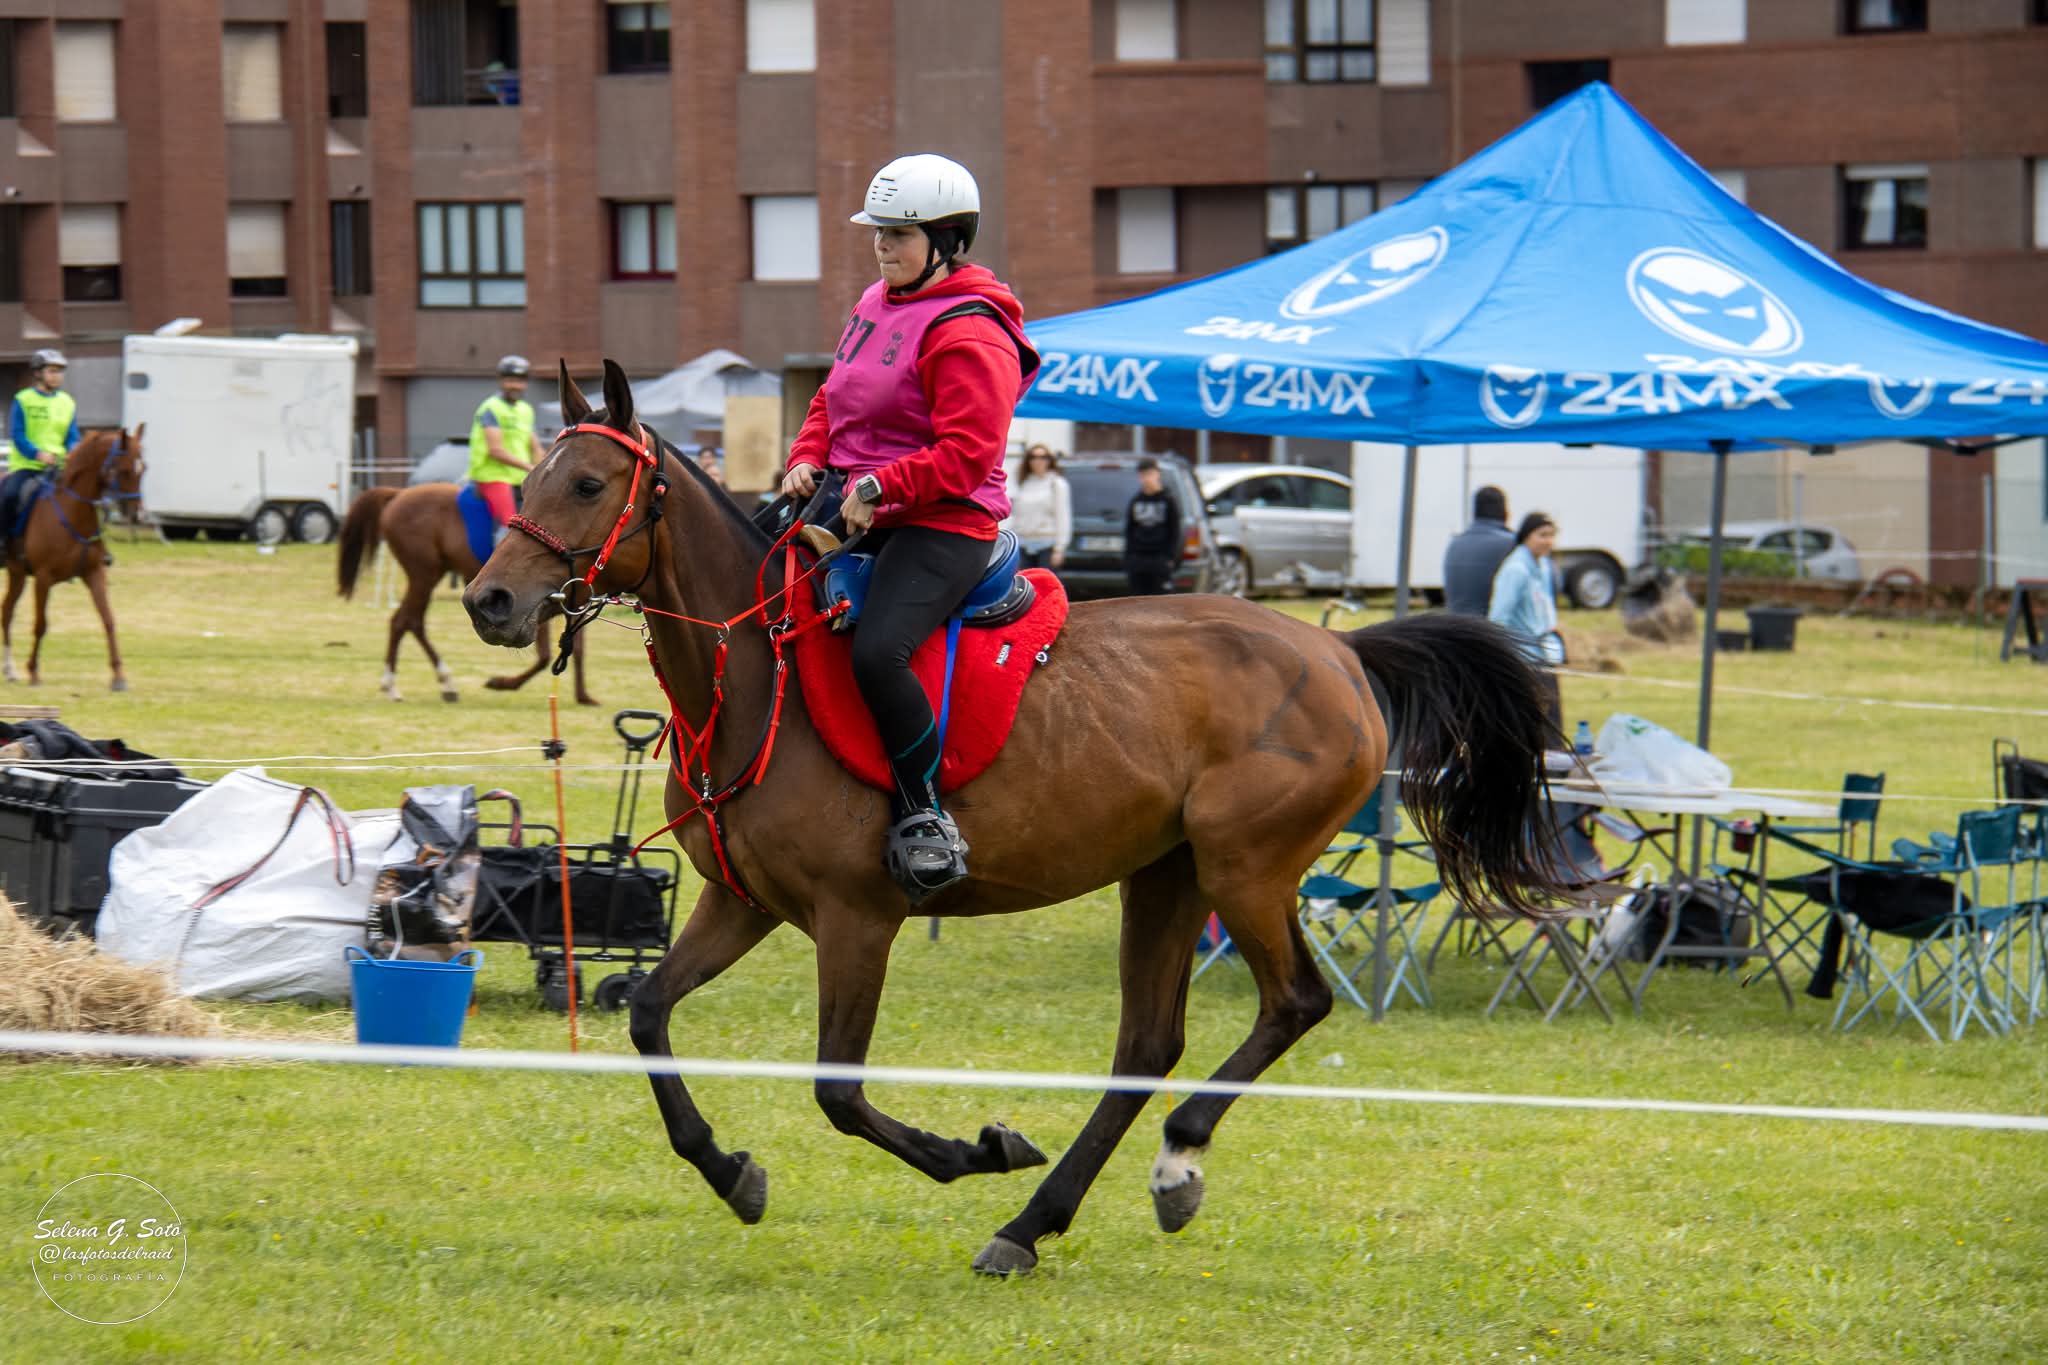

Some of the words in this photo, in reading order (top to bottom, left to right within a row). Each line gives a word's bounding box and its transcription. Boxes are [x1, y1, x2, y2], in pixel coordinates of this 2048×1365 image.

[1037, 351, 1161, 402] 24MX
[1246, 364, 1375, 418] 24MX
[1560, 372, 1793, 414] 24MX
